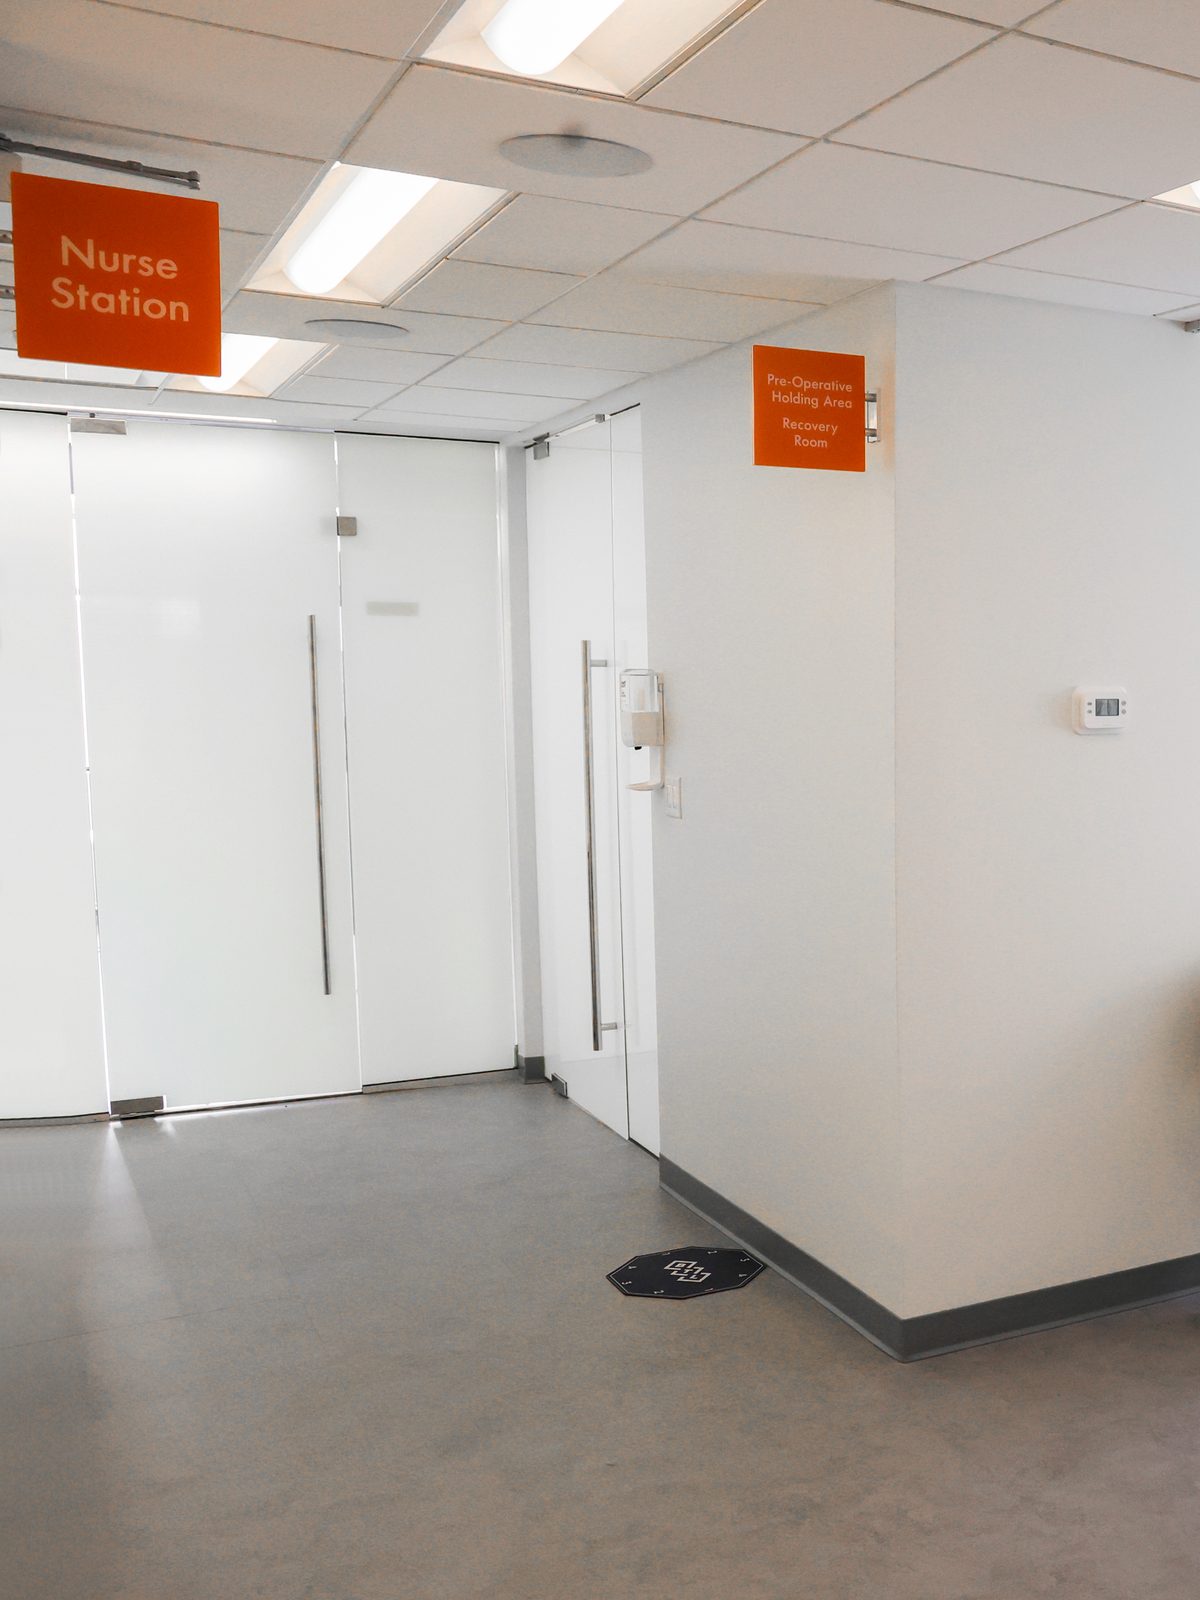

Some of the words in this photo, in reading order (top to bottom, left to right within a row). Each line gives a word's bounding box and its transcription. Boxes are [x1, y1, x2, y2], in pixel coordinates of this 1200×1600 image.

[61, 235, 178, 279] Nurse
[51, 277, 189, 322] Station
[767, 373, 853, 392] Pre-Operative
[772, 390, 819, 409] Holding
[823, 395, 853, 409] Area
[782, 417, 838, 436] Recovery
[794, 434, 828, 448] Room
